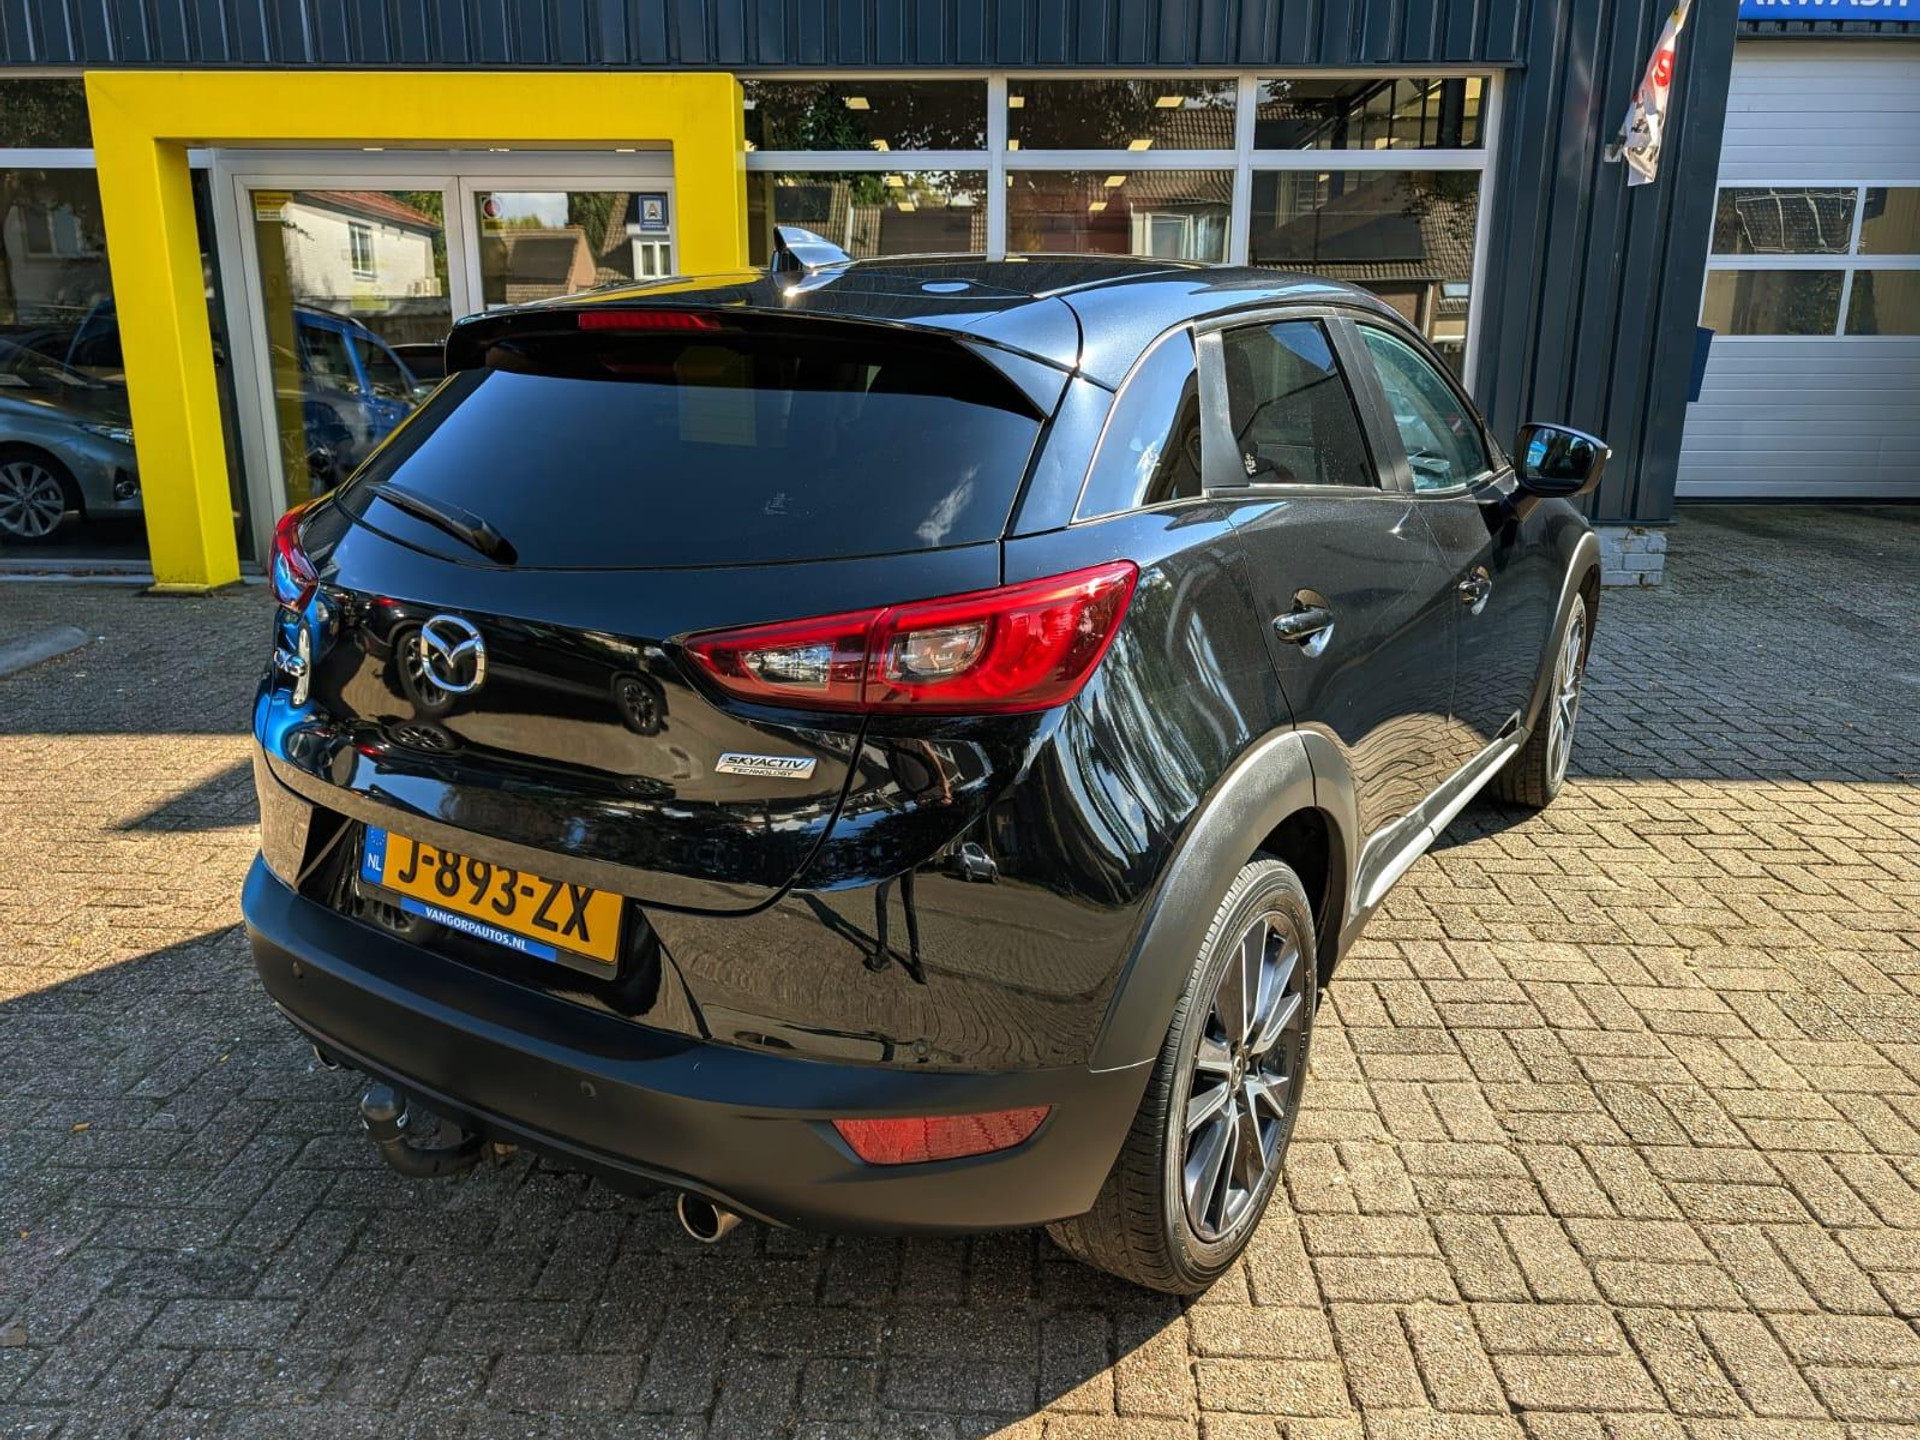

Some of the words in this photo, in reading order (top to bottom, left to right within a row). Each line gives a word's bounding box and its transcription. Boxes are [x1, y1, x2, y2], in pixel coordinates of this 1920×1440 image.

[726, 757, 805, 769] SKYACTIV
[731, 767, 794, 777] TECHNOLOGY
[367, 852, 382, 872] NL
[398, 840, 594, 943] J-893-ZX
[425, 906, 528, 952] VANGORPAUTOS.NL
